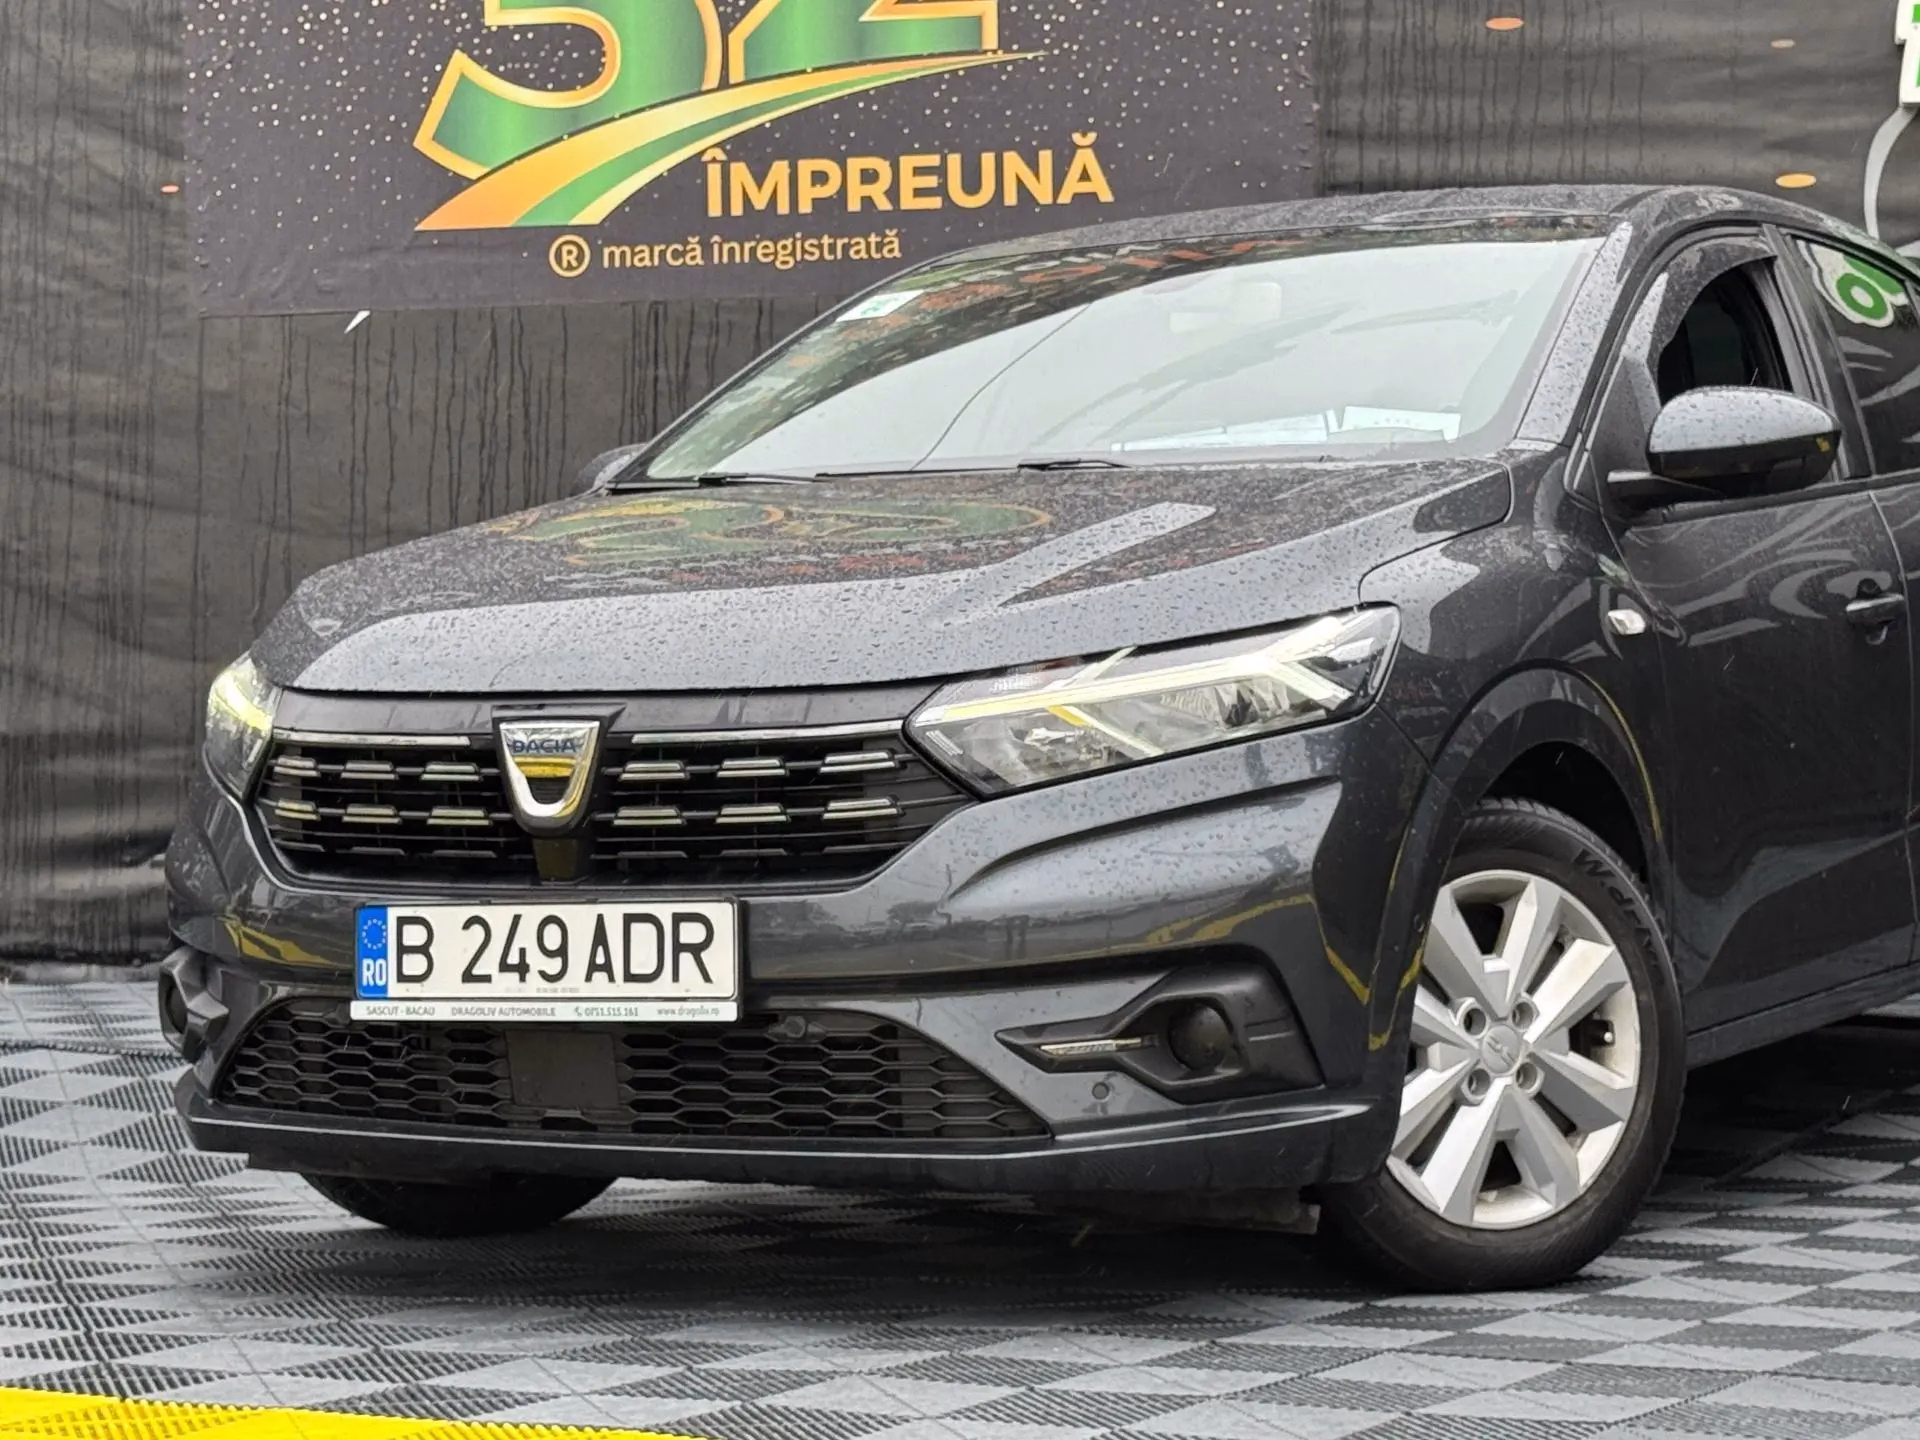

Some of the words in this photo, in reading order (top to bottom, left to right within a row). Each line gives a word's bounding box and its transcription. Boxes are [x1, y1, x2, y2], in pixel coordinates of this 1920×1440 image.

[701, 131, 1115, 218] ÎMPREUNĂ
[602, 236, 705, 270] marcă
[710, 229, 902, 271] înregistrată
[512, 739, 577, 754] DACIA
[396, 915, 435, 985] B
[461, 913, 569, 984] 249
[584, 911, 715, 984] ADR
[362, 957, 387, 987] RO
[365, 1006, 398, 1017] SASCUT
[499, 1006, 557, 1017] AUTOMOBILE
